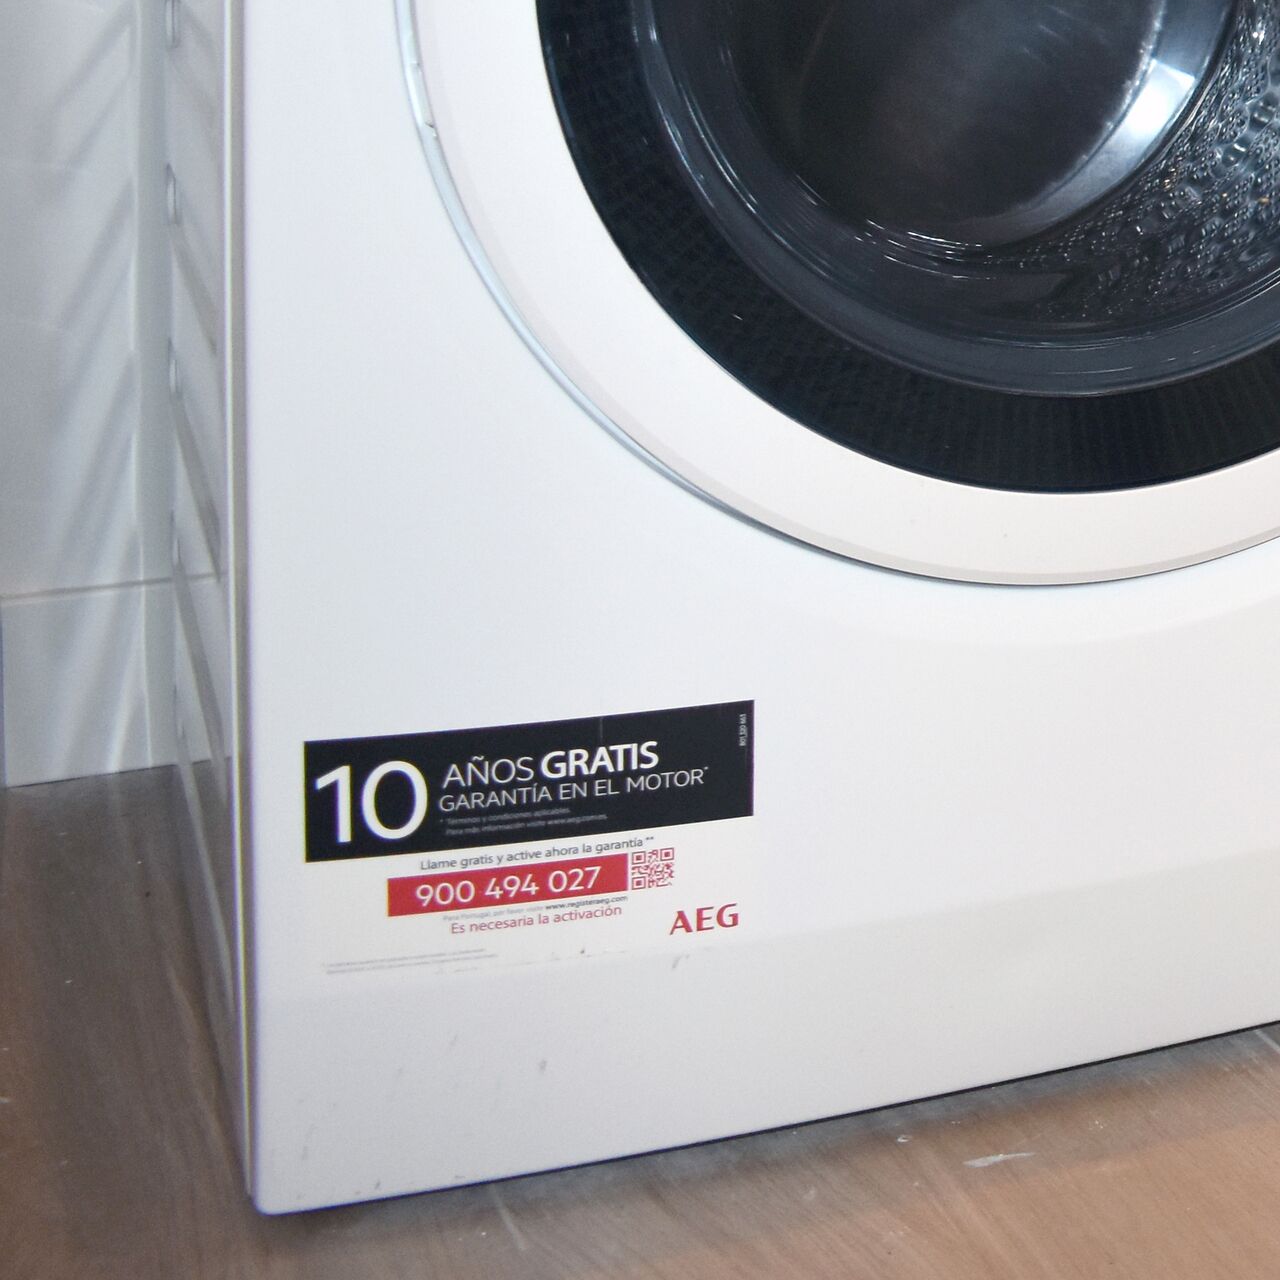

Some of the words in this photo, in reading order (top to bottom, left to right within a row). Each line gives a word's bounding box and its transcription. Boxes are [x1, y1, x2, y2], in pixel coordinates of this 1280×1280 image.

[442, 755, 535, 790] AÑOS
[540, 740, 660, 780] GRATIS
[314, 760, 428, 845] 10
[439, 782, 552, 812] GARANTÍA
[559, 782, 588, 800] EN
[595, 778, 620, 796] EL
[420, 858, 458, 871] Llame
[460, 854, 494, 869] gratis
[497, 855, 504, 866] y
[506, 849, 542, 862] active
[545, 845, 579, 858] ahora
[582, 843, 593, 854] la
[595, 838, 644, 854] garantía
[416, 880, 476, 907] 900
[484, 873, 540, 899] 494
[548, 866, 602, 893] 027
[451, 922, 465, 934] Es
[469, 916, 535, 932] necesaria
[538, 914, 550, 925] la
[553, 904, 622, 923] activación
[669, 903, 740, 936] AEG
